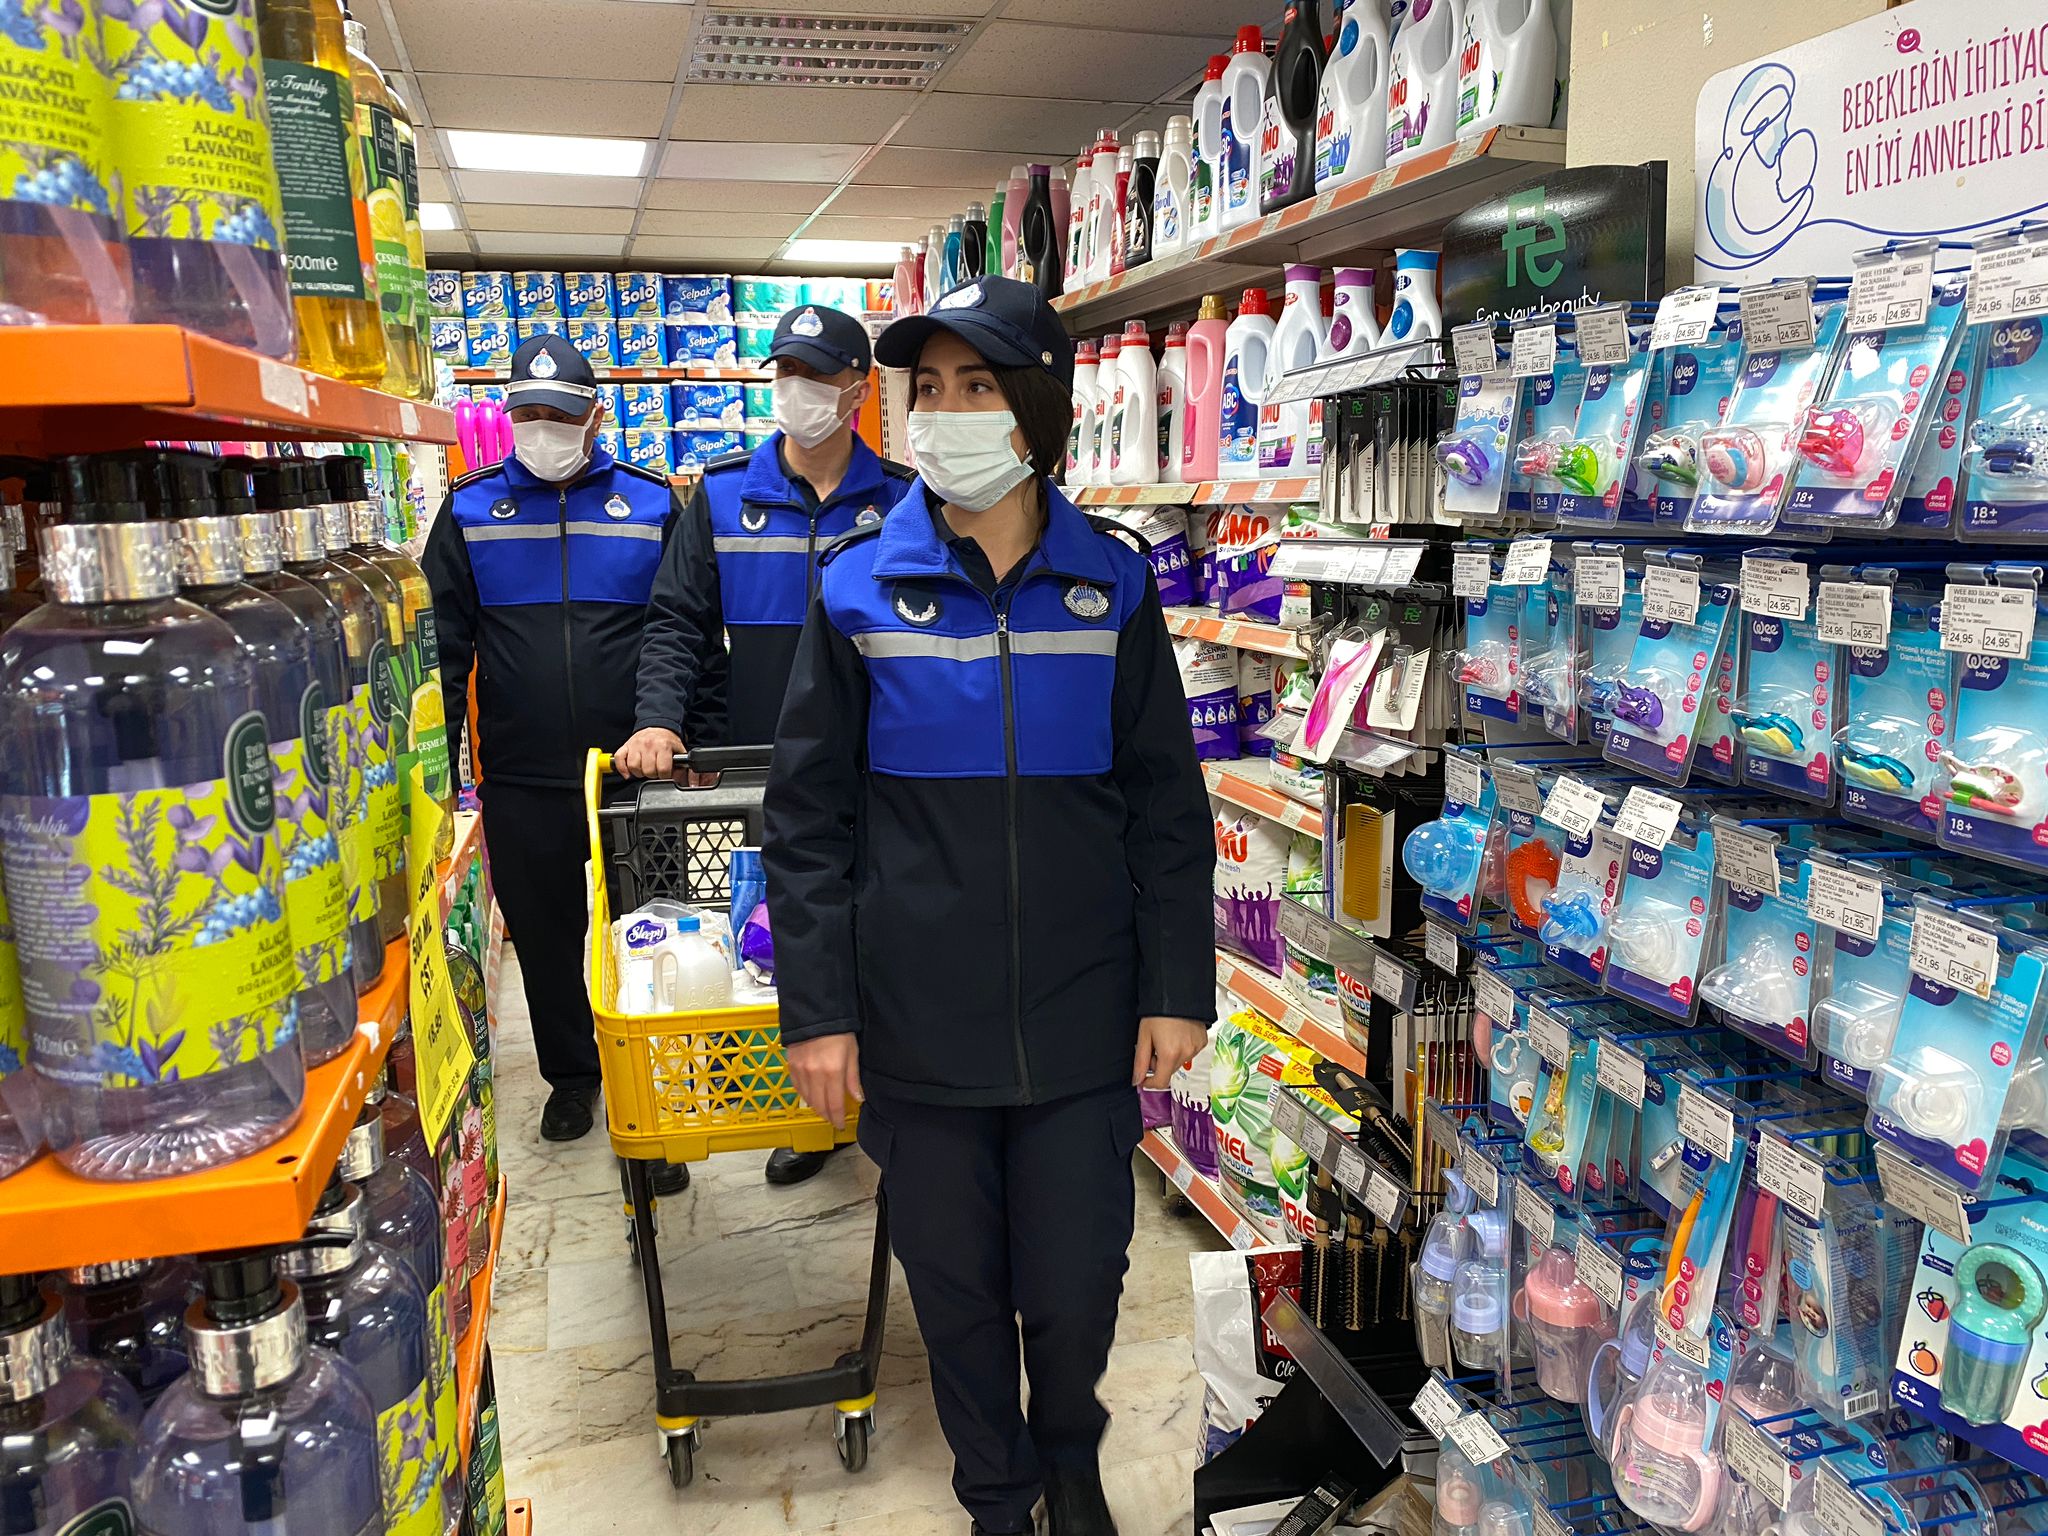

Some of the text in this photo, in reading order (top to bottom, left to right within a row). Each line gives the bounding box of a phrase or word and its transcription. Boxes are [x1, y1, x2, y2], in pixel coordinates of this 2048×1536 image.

[1842, 50, 1958, 133] BEBEKLERİN
[193, 120, 255, 146] ALAÇATI
[183, 137, 264, 167] LAVANTASI
[1845, 150, 1869, 196] EN
[1874, 129, 1902, 189] İYİ
[1907, 98, 2012, 181] ANNELERİ
[191, 172, 222, 188] SIVI
[466, 285, 502, 306] Solo
[518, 285, 554, 306] Solo
[569, 285, 605, 307] Solo
[620, 285, 656, 307] Solo
[680, 285, 712, 300] Selpak
[1540, 286, 1601, 315] beauty
[1976, 293, 2042, 314] 24,95 24,95
[1855, 308, 1911, 325] 24,95 24,95
[573, 333, 608, 353] Solo
[688, 333, 720, 349] Selpak
[1677, 329, 1696, 339] 24,95
[1754, 328, 1800, 343] 24,95 24,95
[1992, 326, 2035, 347] Wee
[472, 334, 508, 354] Solo
[623, 333, 658, 354] Solo
[1674, 364, 1695, 378] Wee
[1748, 355, 1777, 372] Wee
[628, 396, 663, 417] Solo
[695, 393, 726, 408] Selpak
[1222, 389, 1238, 410] ABC
[630, 443, 666, 463] Solo
[694, 439, 728, 453] Selpak
[1795, 491, 1814, 503] 18+
[1972, 507, 1998, 520] 18+
[1769, 600, 1790, 611] 24,95
[1752, 620, 1779, 636] Wee
[1824, 625, 1873, 639] 24,95 24,95
[1949, 632, 2010, 648] 24,95 24,95
[1966, 653, 2001, 669] Wee
[1612, 734, 1630, 748] 6-18
[1848, 790, 1866, 803] 18+
[1951, 818, 1973, 831] 18+
[1632, 848, 1657, 866] Wee
[1815, 904, 1864, 928] 21,95 21,95
[627, 924, 667, 943] Sleepy
[1918, 953, 1974, 985] 21,95 21,95
[1924, 982, 1941, 994] baby
[1832, 1059, 1854, 1077] 6-18
[1216, 1126, 1254, 1166] RIEL
[1228, 1156, 1254, 1178] PUDRA
[1897, 1379, 1919, 1398] 6+
